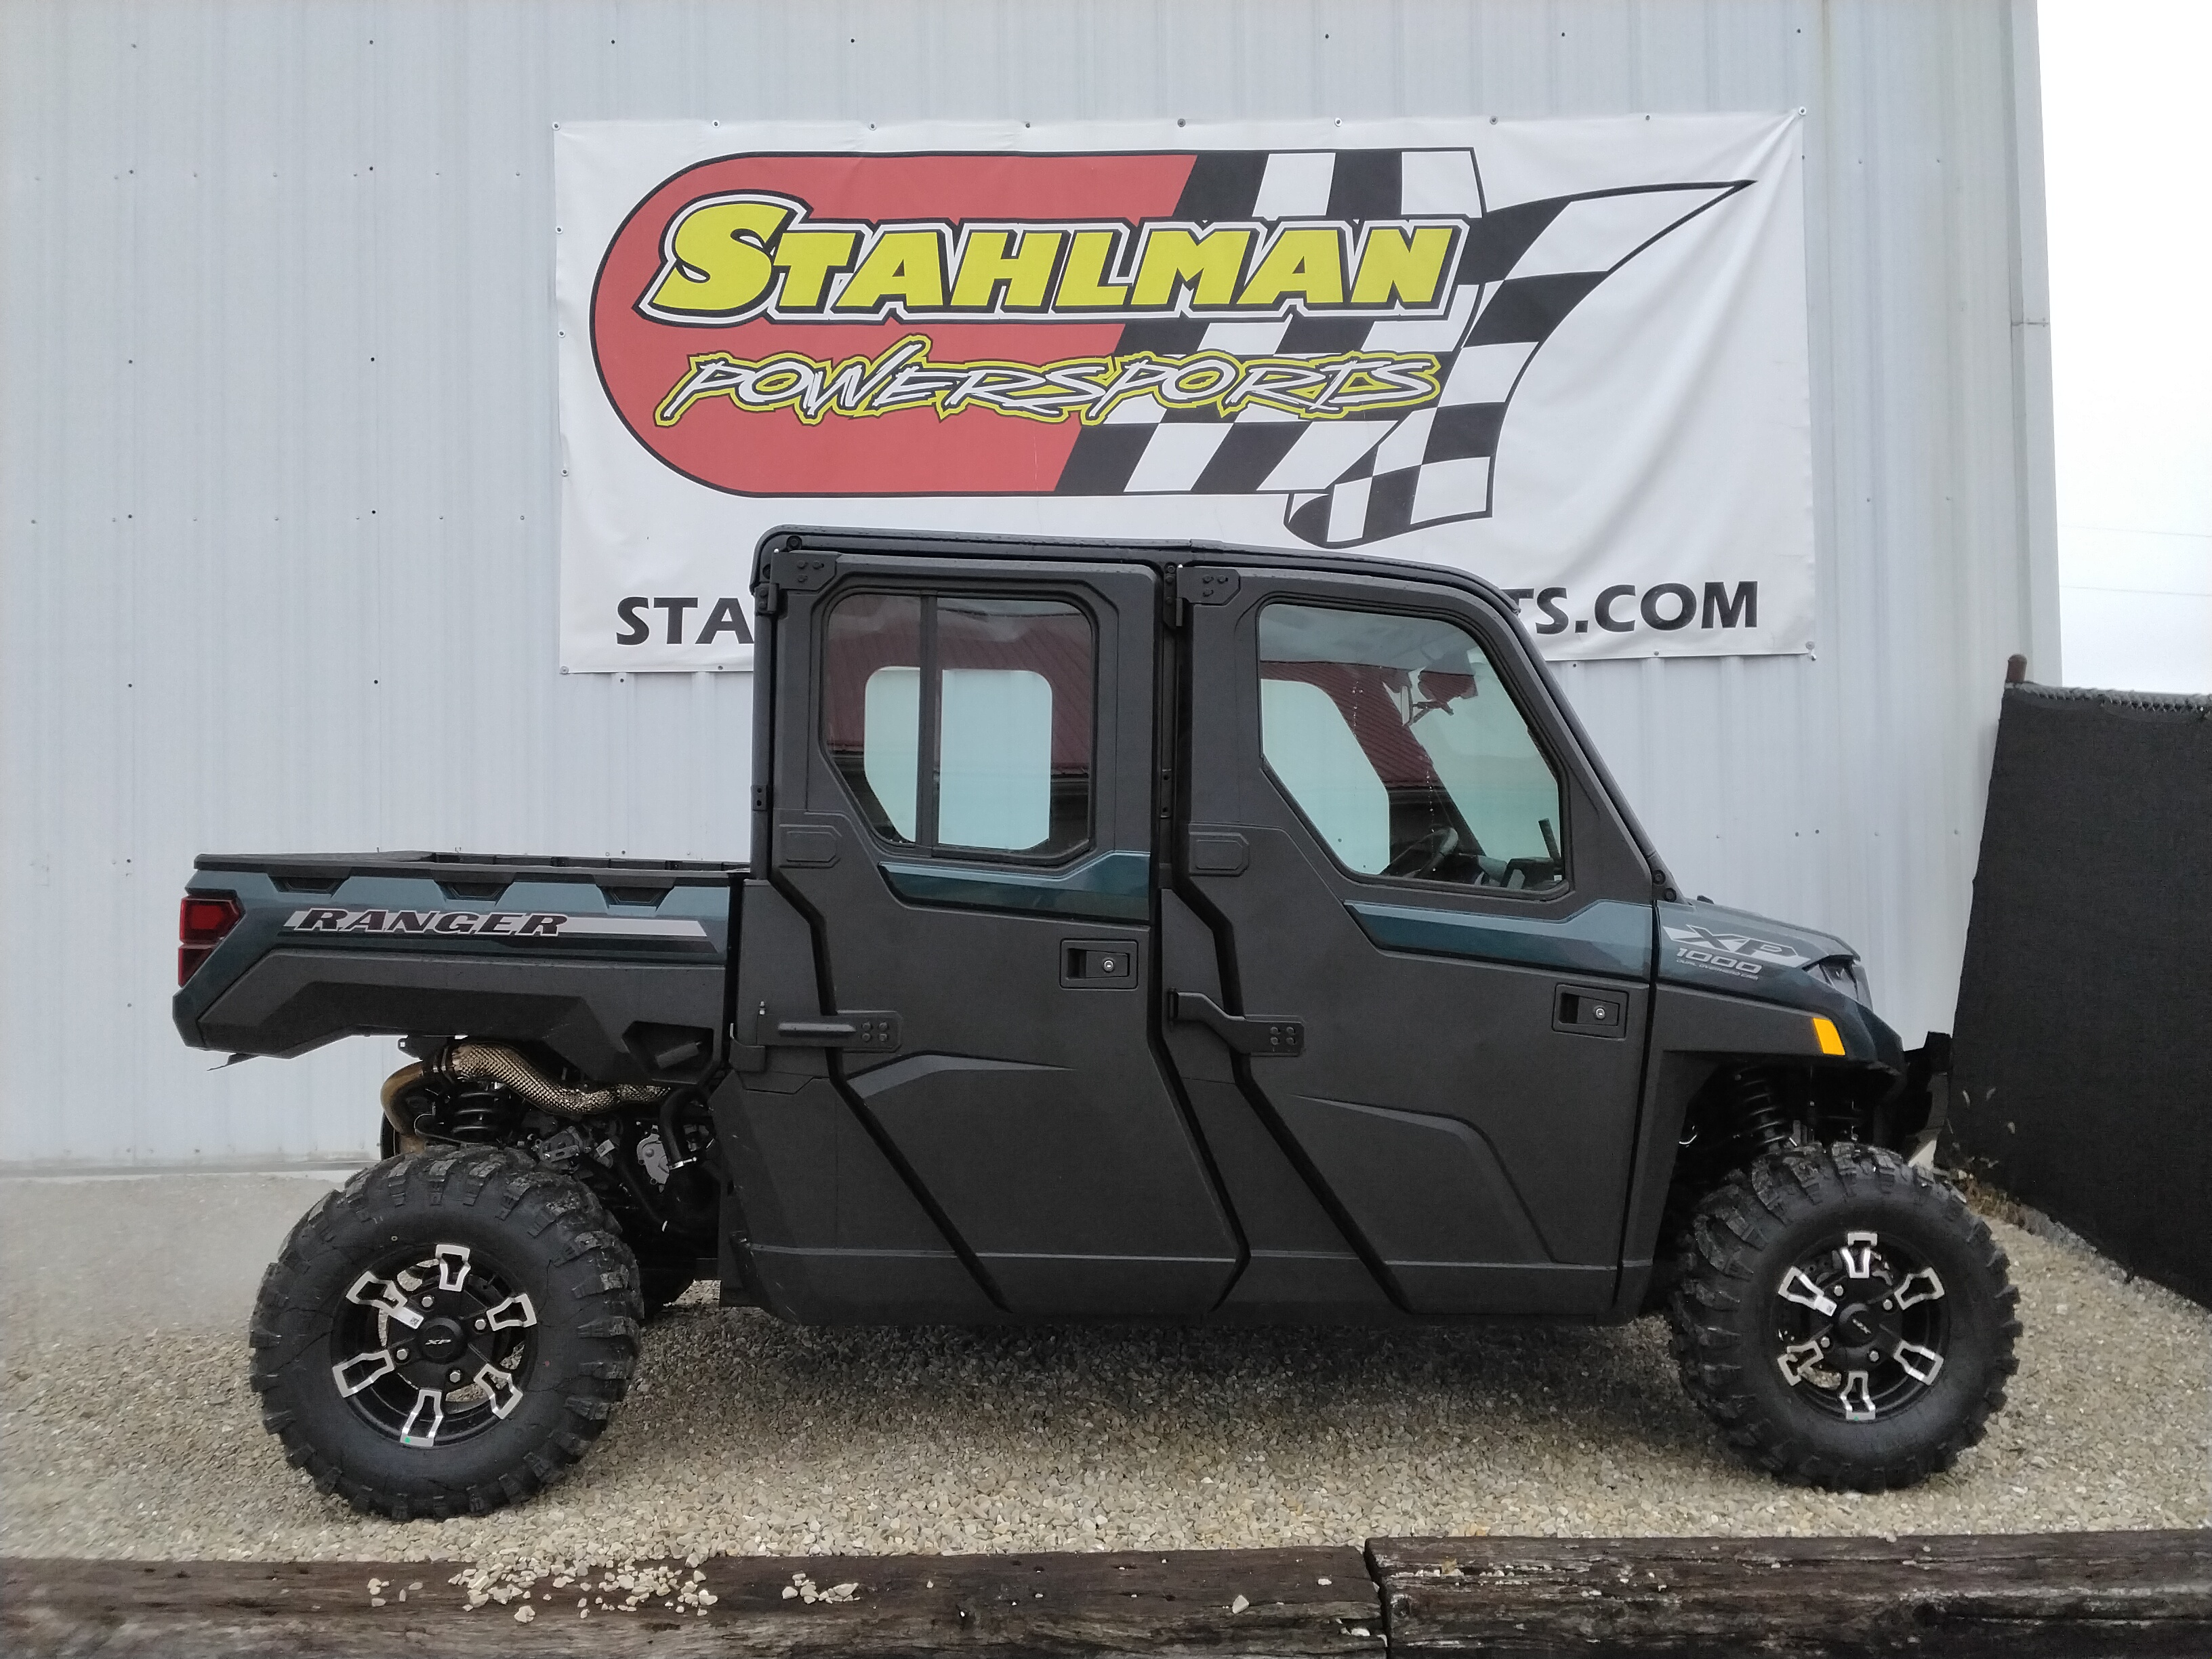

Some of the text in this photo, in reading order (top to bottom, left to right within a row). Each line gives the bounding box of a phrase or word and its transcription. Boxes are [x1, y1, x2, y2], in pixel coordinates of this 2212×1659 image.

[640, 194, 1466, 321] STAHLMAN
[656, 335, 1439, 426] POWERSPORTS
[616, 596, 754, 645] STA
[294, 907, 568, 937] RANGER
[1671, 924, 1801, 958] XP
[1677, 947, 1762, 974] 1000
